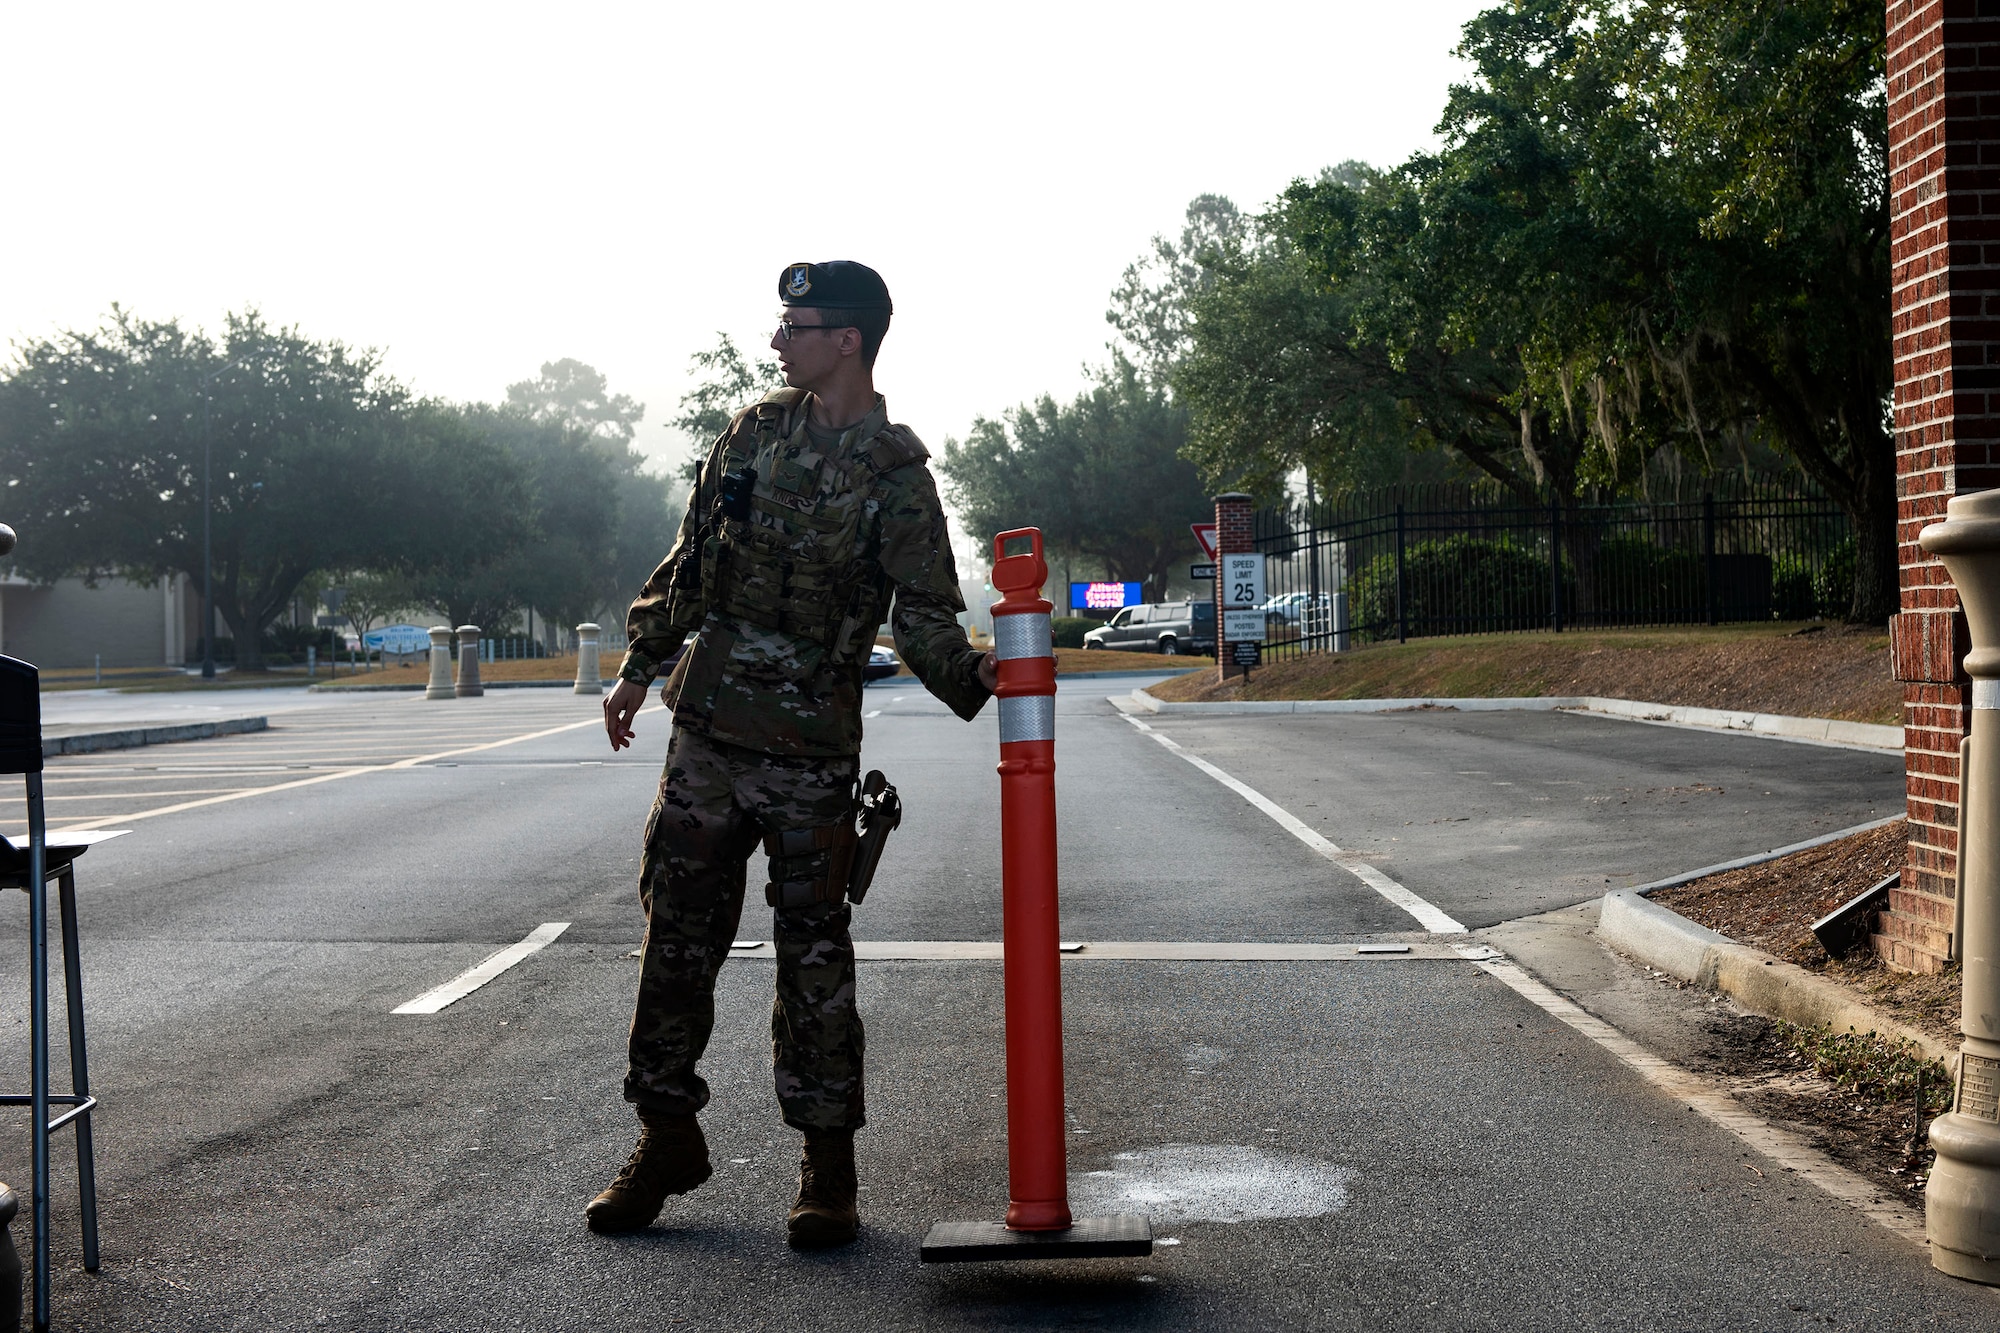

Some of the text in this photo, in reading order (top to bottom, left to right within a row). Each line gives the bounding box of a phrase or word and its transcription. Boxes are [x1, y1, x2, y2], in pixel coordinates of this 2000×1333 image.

[1232, 559, 1255, 568] SPEED
[1235, 570, 1253, 579] LIMIT
[1234, 583, 1254, 602] 25
